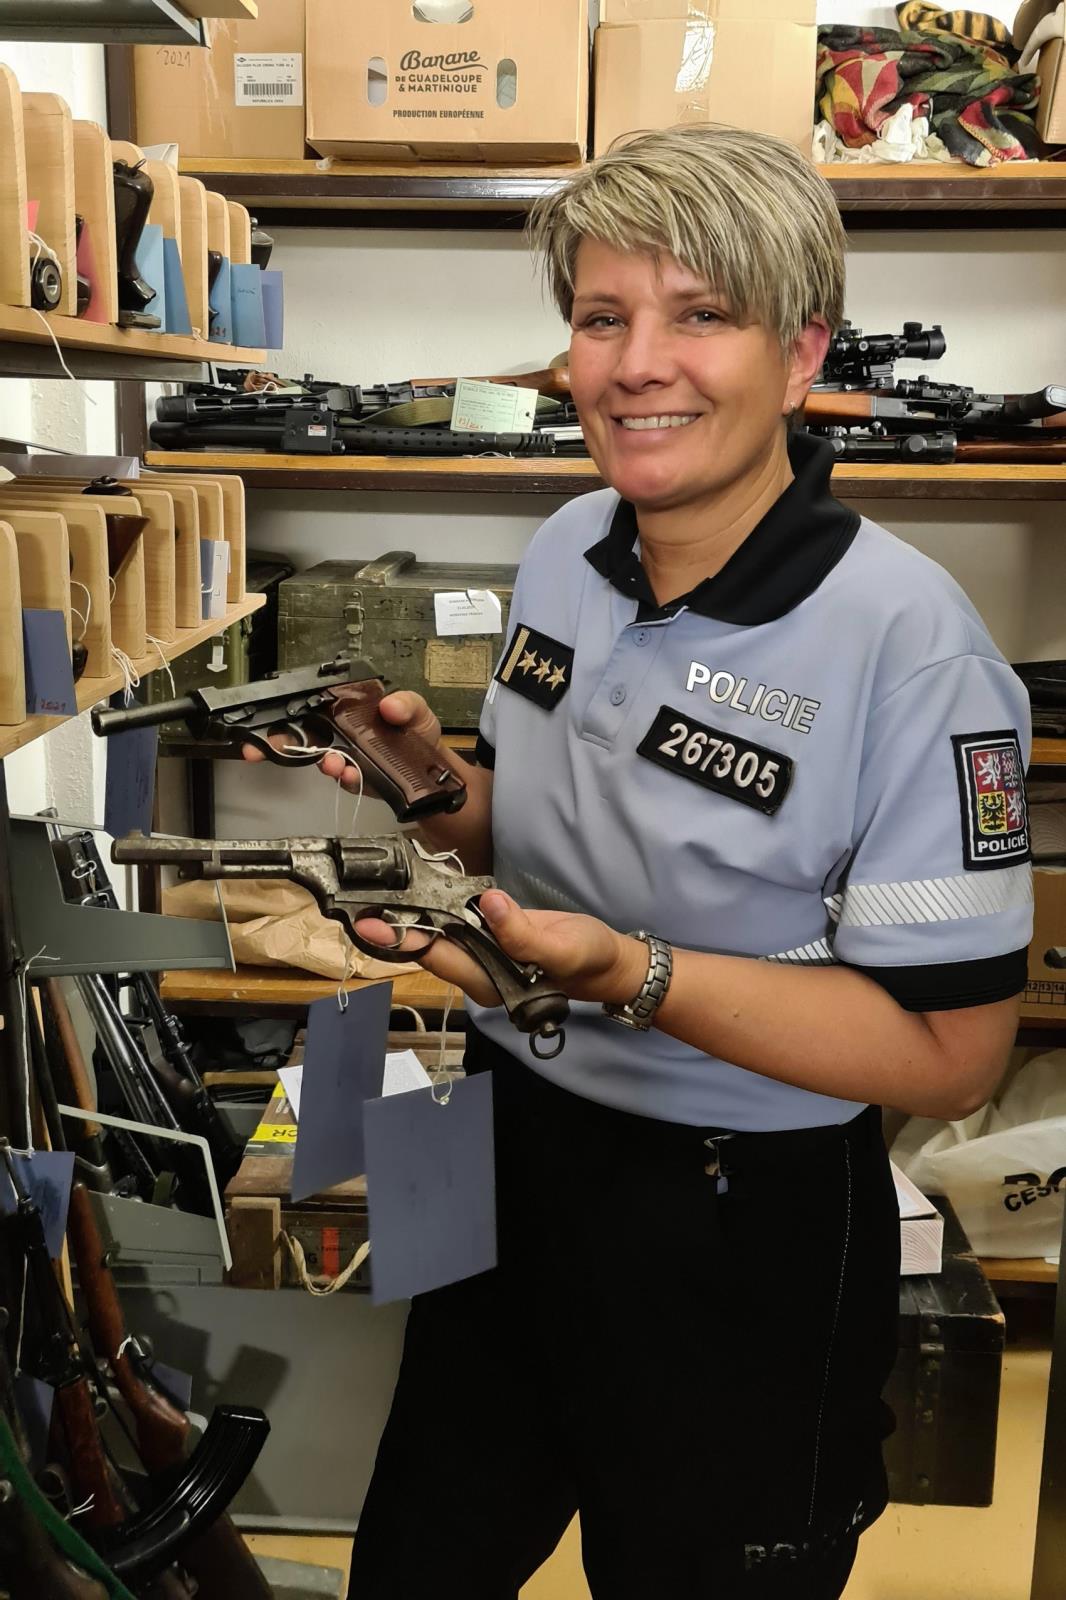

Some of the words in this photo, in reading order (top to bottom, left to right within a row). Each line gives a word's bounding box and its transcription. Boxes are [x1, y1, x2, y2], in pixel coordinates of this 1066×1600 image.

[400, 50, 489, 72] Banane
[398, 84, 406, 93] &
[408, 84, 478, 93] MARTINIQUE
[408, 74, 483, 84] GUADELOUPE
[393, 109, 438, 119] PRODUCTION
[439, 108, 485, 119] EUROPÉENNE
[685, 659, 822, 734] POLICIE
[657, 722, 780, 798] 267305
[977, 833, 1026, 854] POLICIE
